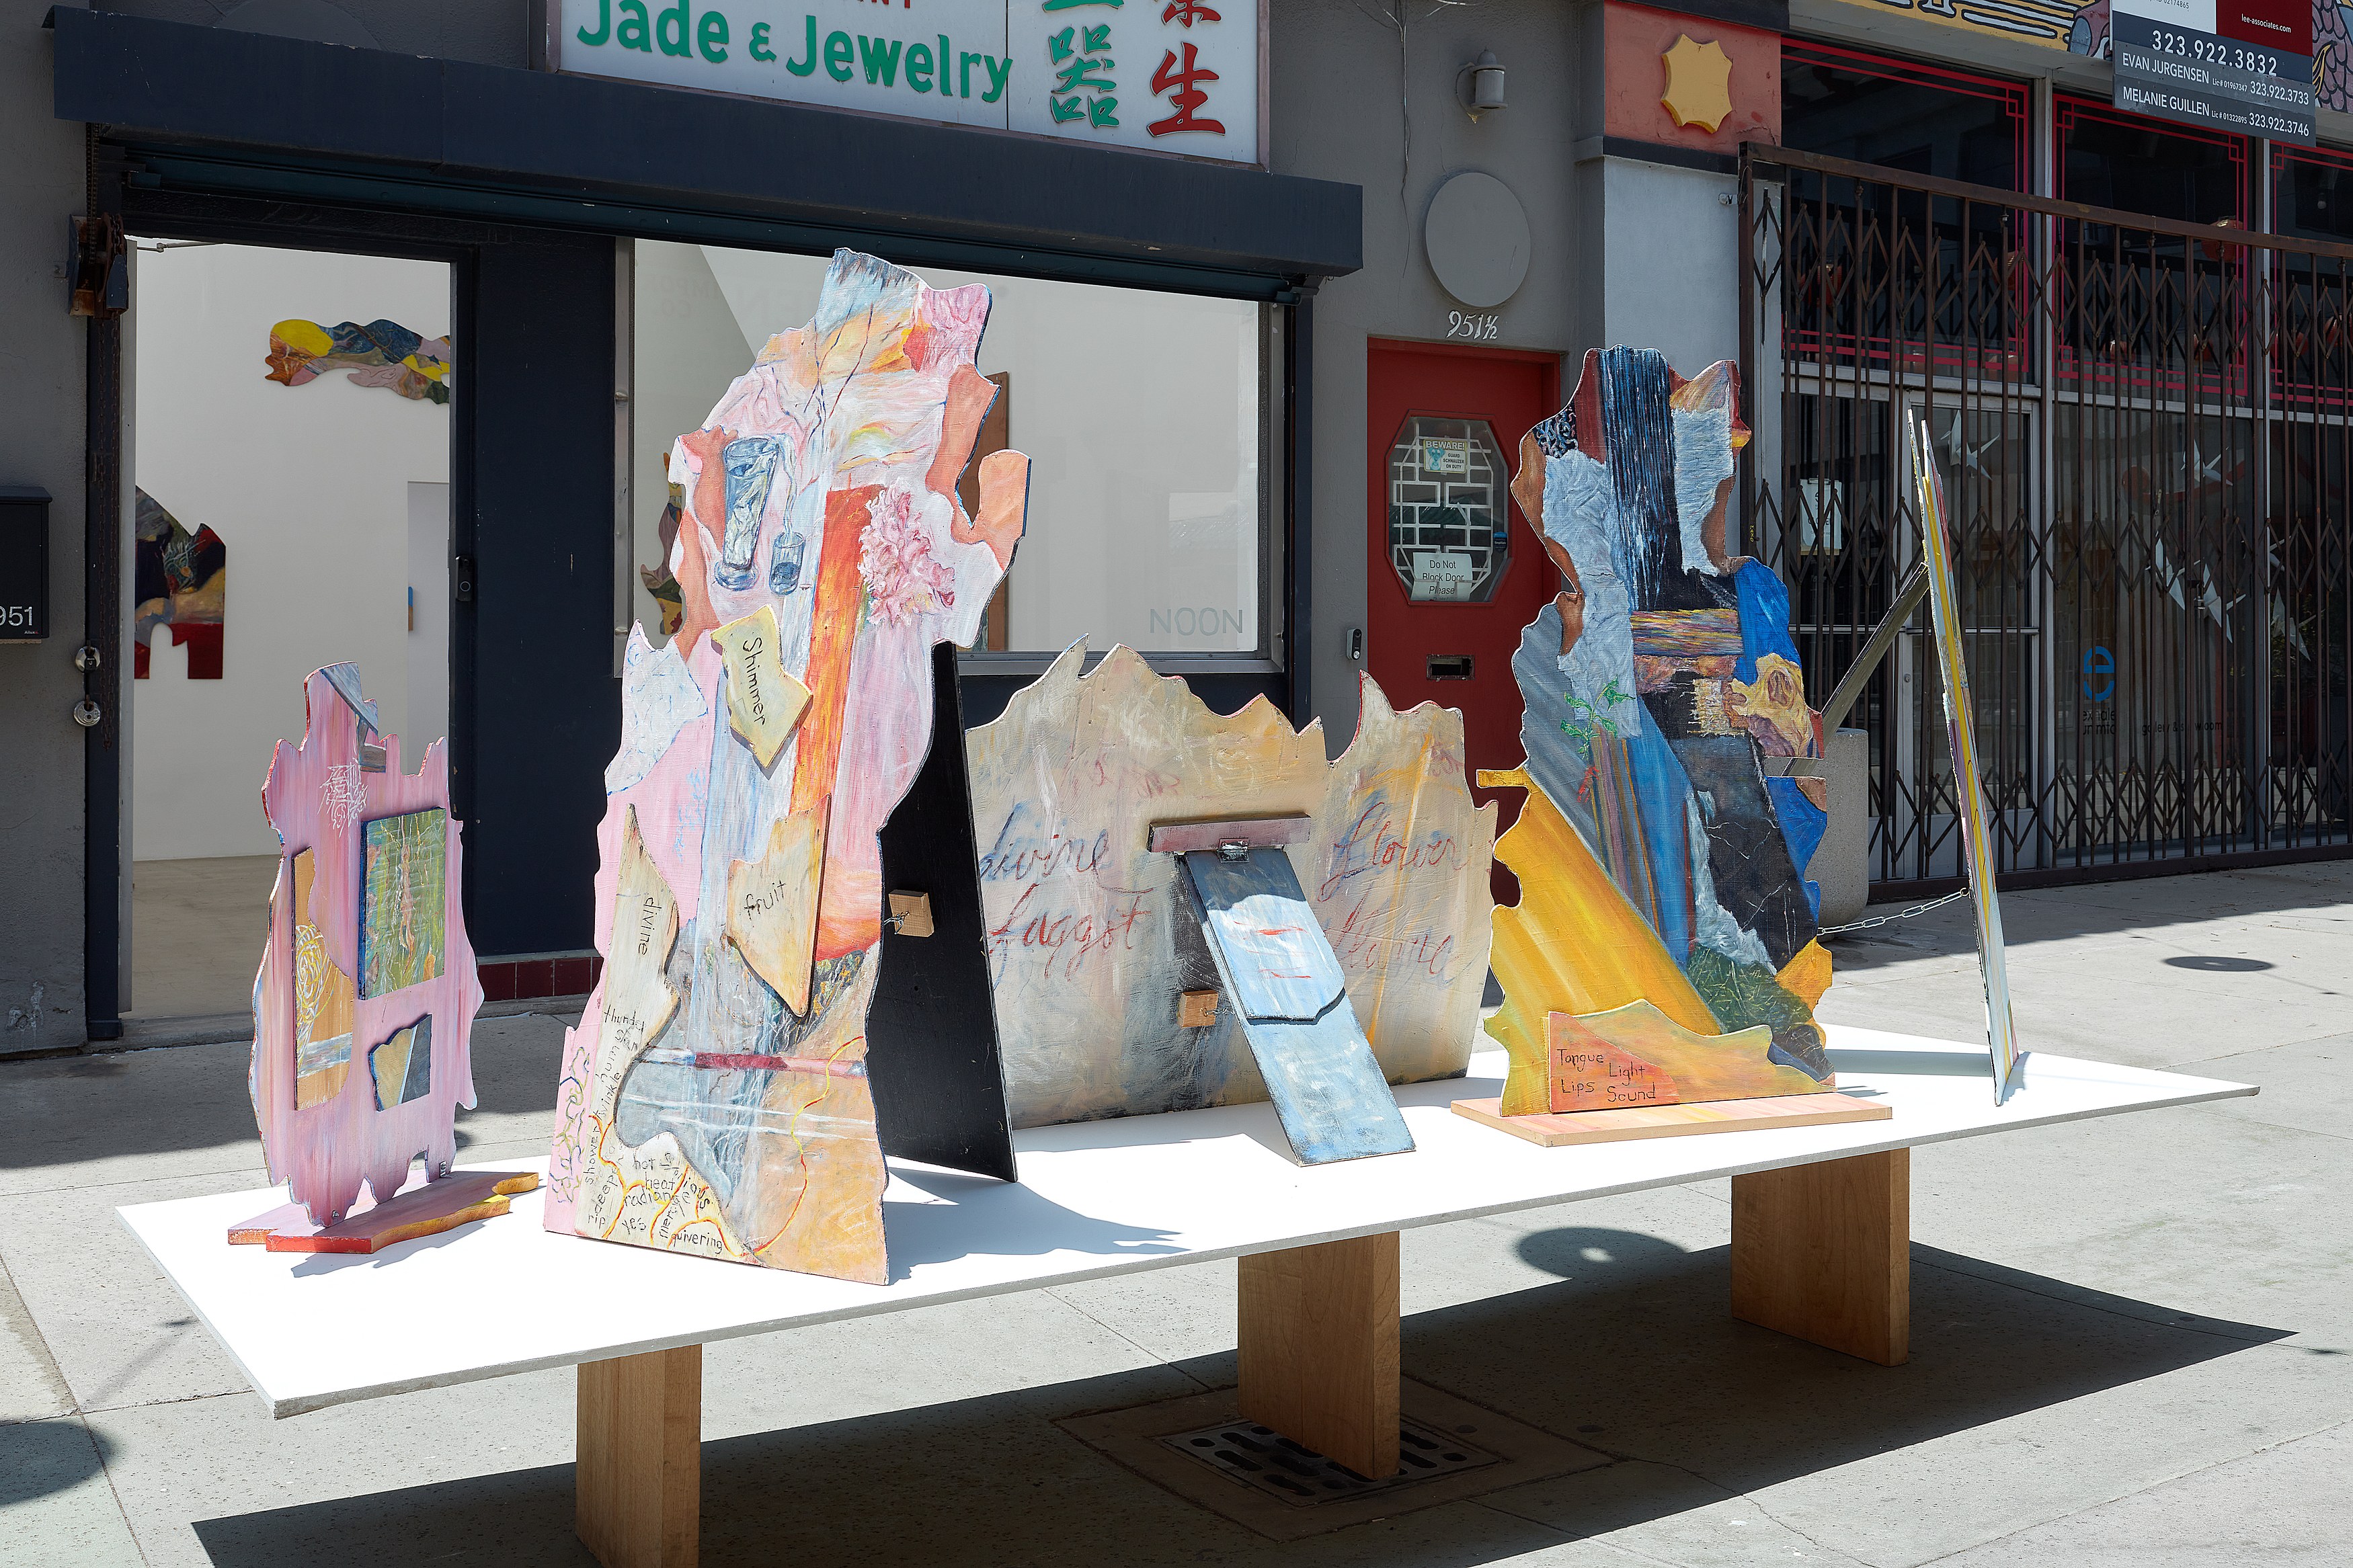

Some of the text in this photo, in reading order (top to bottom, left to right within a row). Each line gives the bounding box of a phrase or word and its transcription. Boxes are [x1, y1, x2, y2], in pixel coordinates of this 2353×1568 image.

[2241, 13, 2291, 33] lee-associates.com
[576, 0, 1013, 103] Jade & Jewelry
[2152, 30, 2277, 77] 323.922.3832
[2122, 52, 2150, 71] EVAN
[2151, 59, 2209, 84] JURGENSEN
[2223, 81, 2247, 92] 01967347
[2250, 81, 2309, 106] 323.922.3733
[2123, 86, 2167, 108] MELANIE
[2169, 96, 2210, 116] GUILLEN
[2223, 113, 2247, 124] 01322895
[2249, 112, 2310, 136] 323.922.3746
[1425, 440, 1465, 450] BEWARE!
[1429, 560, 1456, 569] Do Not
[1445, 573, 1464, 582] Door
[1150, 607, 1243, 636] NOON
[742, 637, 766, 725] Shimmer
[744, 880, 786, 921] fruit
[638, 897, 662, 956] divine
[1609, 1061, 1646, 1085] Light
[1560, 1079, 1595, 1097] Lips
[645, 1171, 676, 1191] heat
[588, 1214, 606, 1230] rip
[621, 1217, 647, 1235] yes
